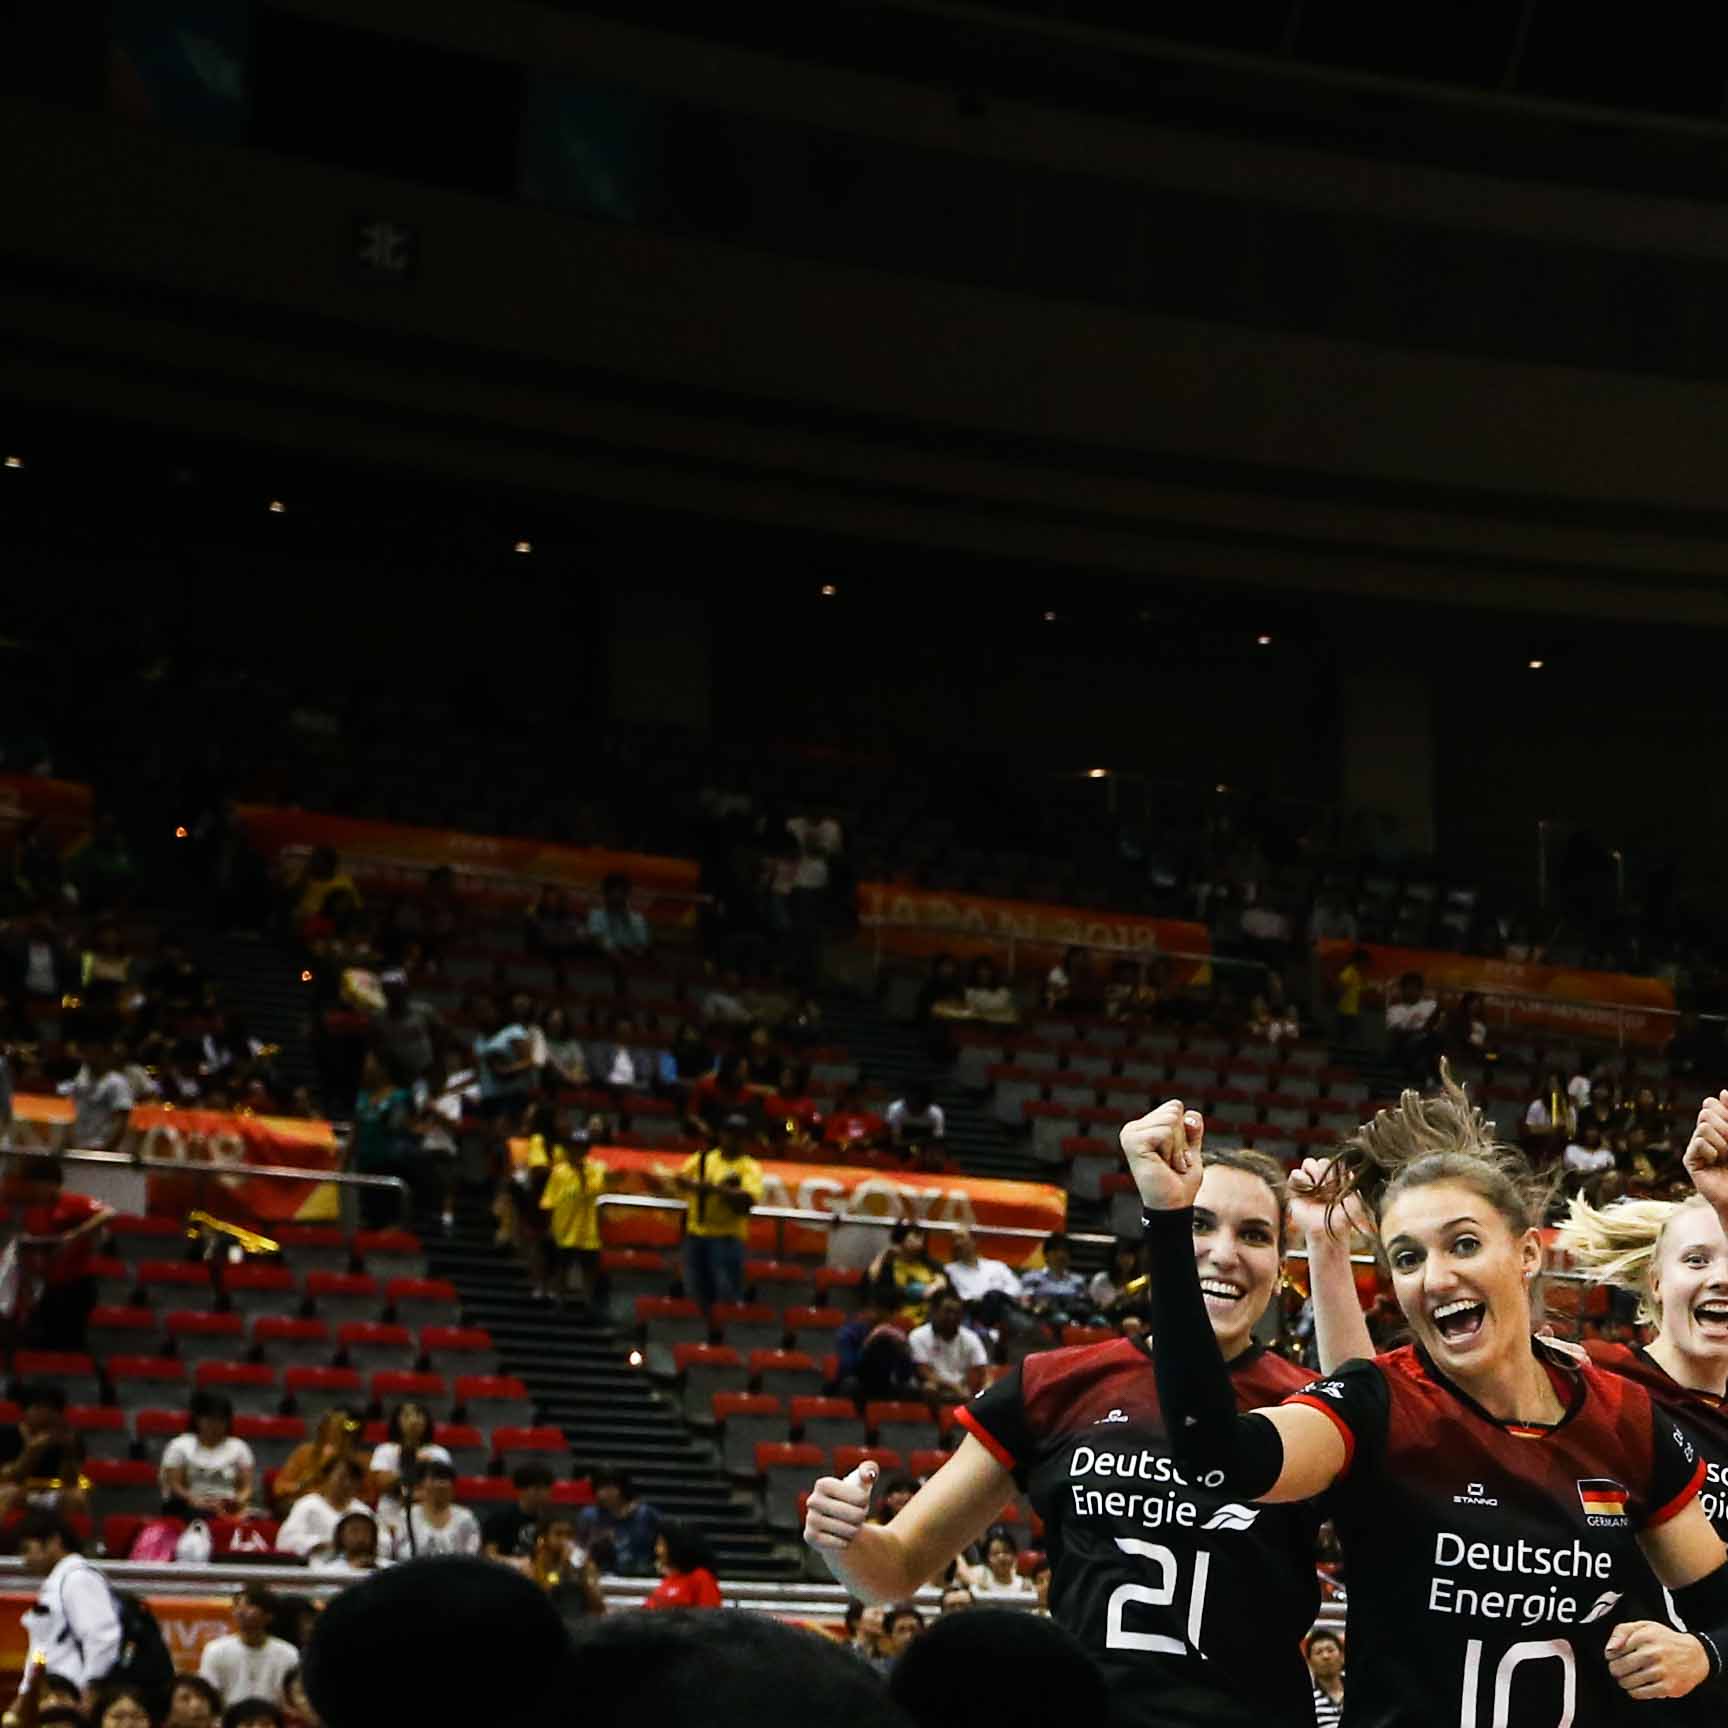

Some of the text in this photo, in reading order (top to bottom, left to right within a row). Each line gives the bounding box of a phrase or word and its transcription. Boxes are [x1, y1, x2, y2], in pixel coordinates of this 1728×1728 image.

[1072, 1485, 1198, 1528] Energie
[1434, 1532, 1612, 1579] Deutsche
[1105, 1537, 1209, 1660] 21
[1428, 1577, 1577, 1627] Energie
